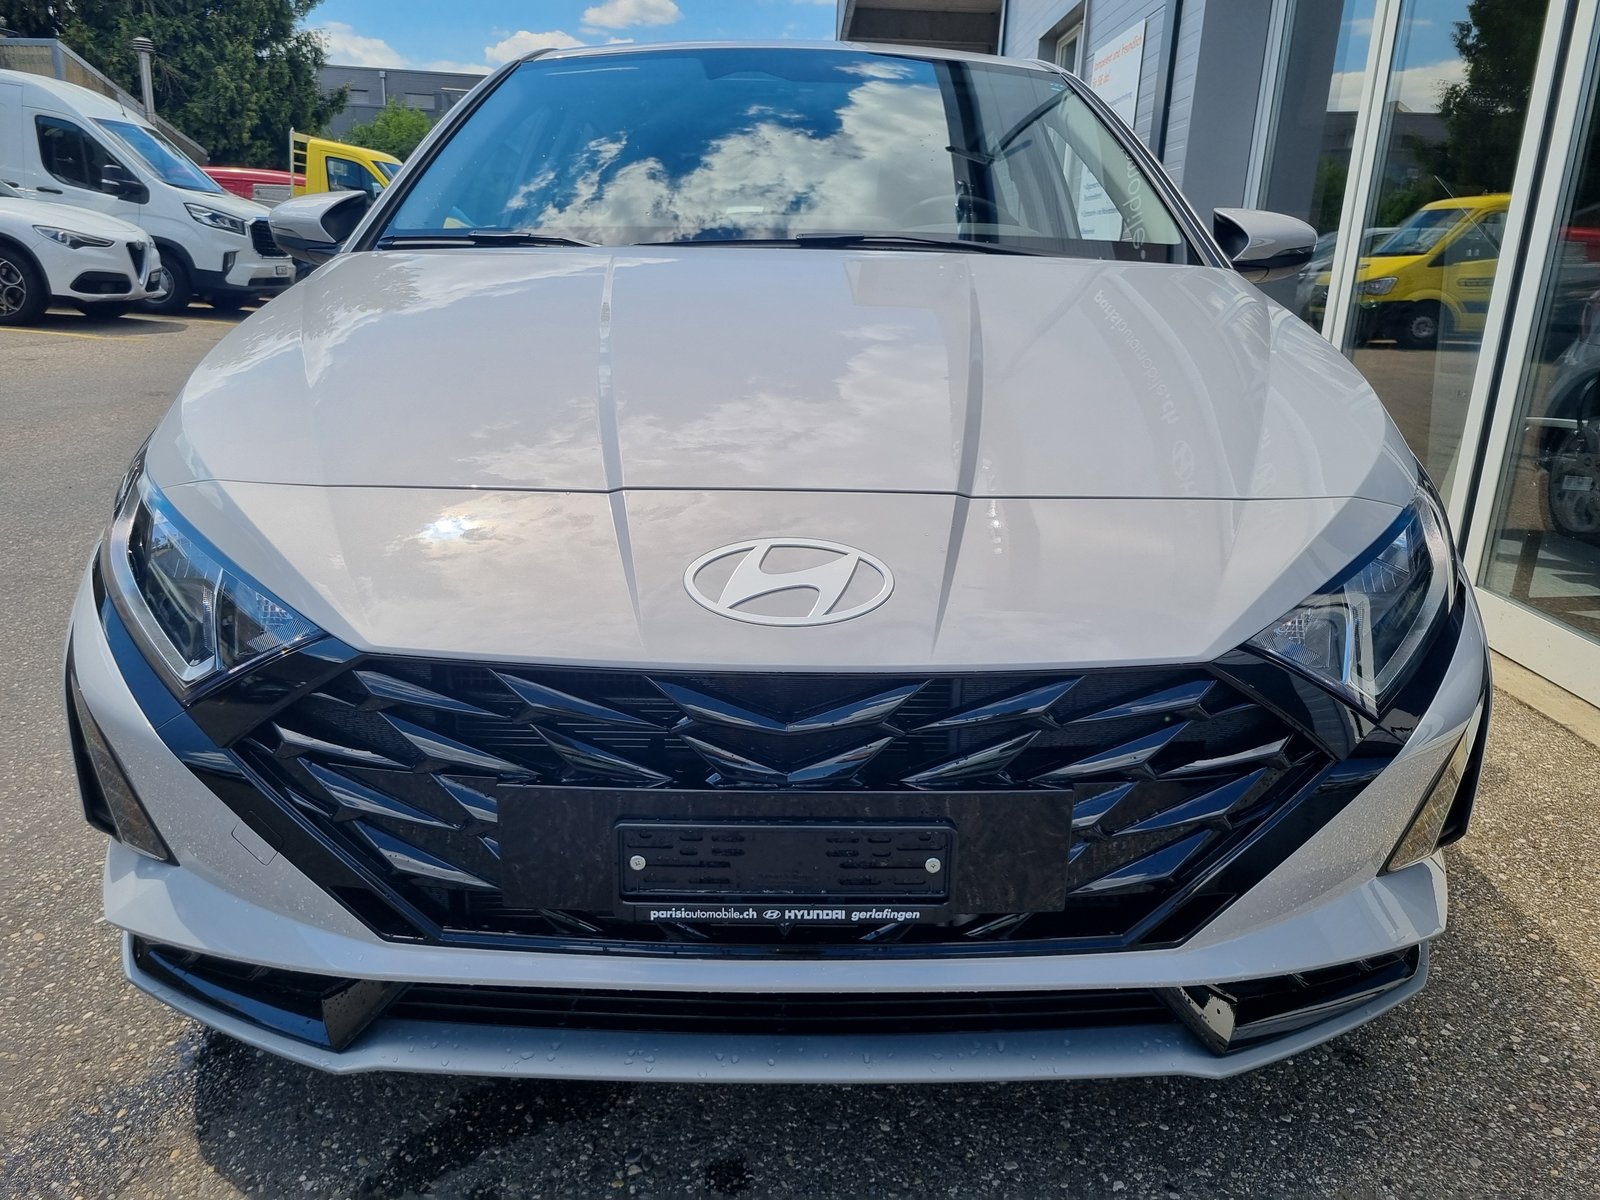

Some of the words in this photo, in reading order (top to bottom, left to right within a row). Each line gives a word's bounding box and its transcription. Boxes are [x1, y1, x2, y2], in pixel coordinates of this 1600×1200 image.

[650, 907, 757, 921] parisiautomobile.ch
[784, 909, 846, 920] HYUNDAI
[850, 908, 920, 921] gerlafingen
